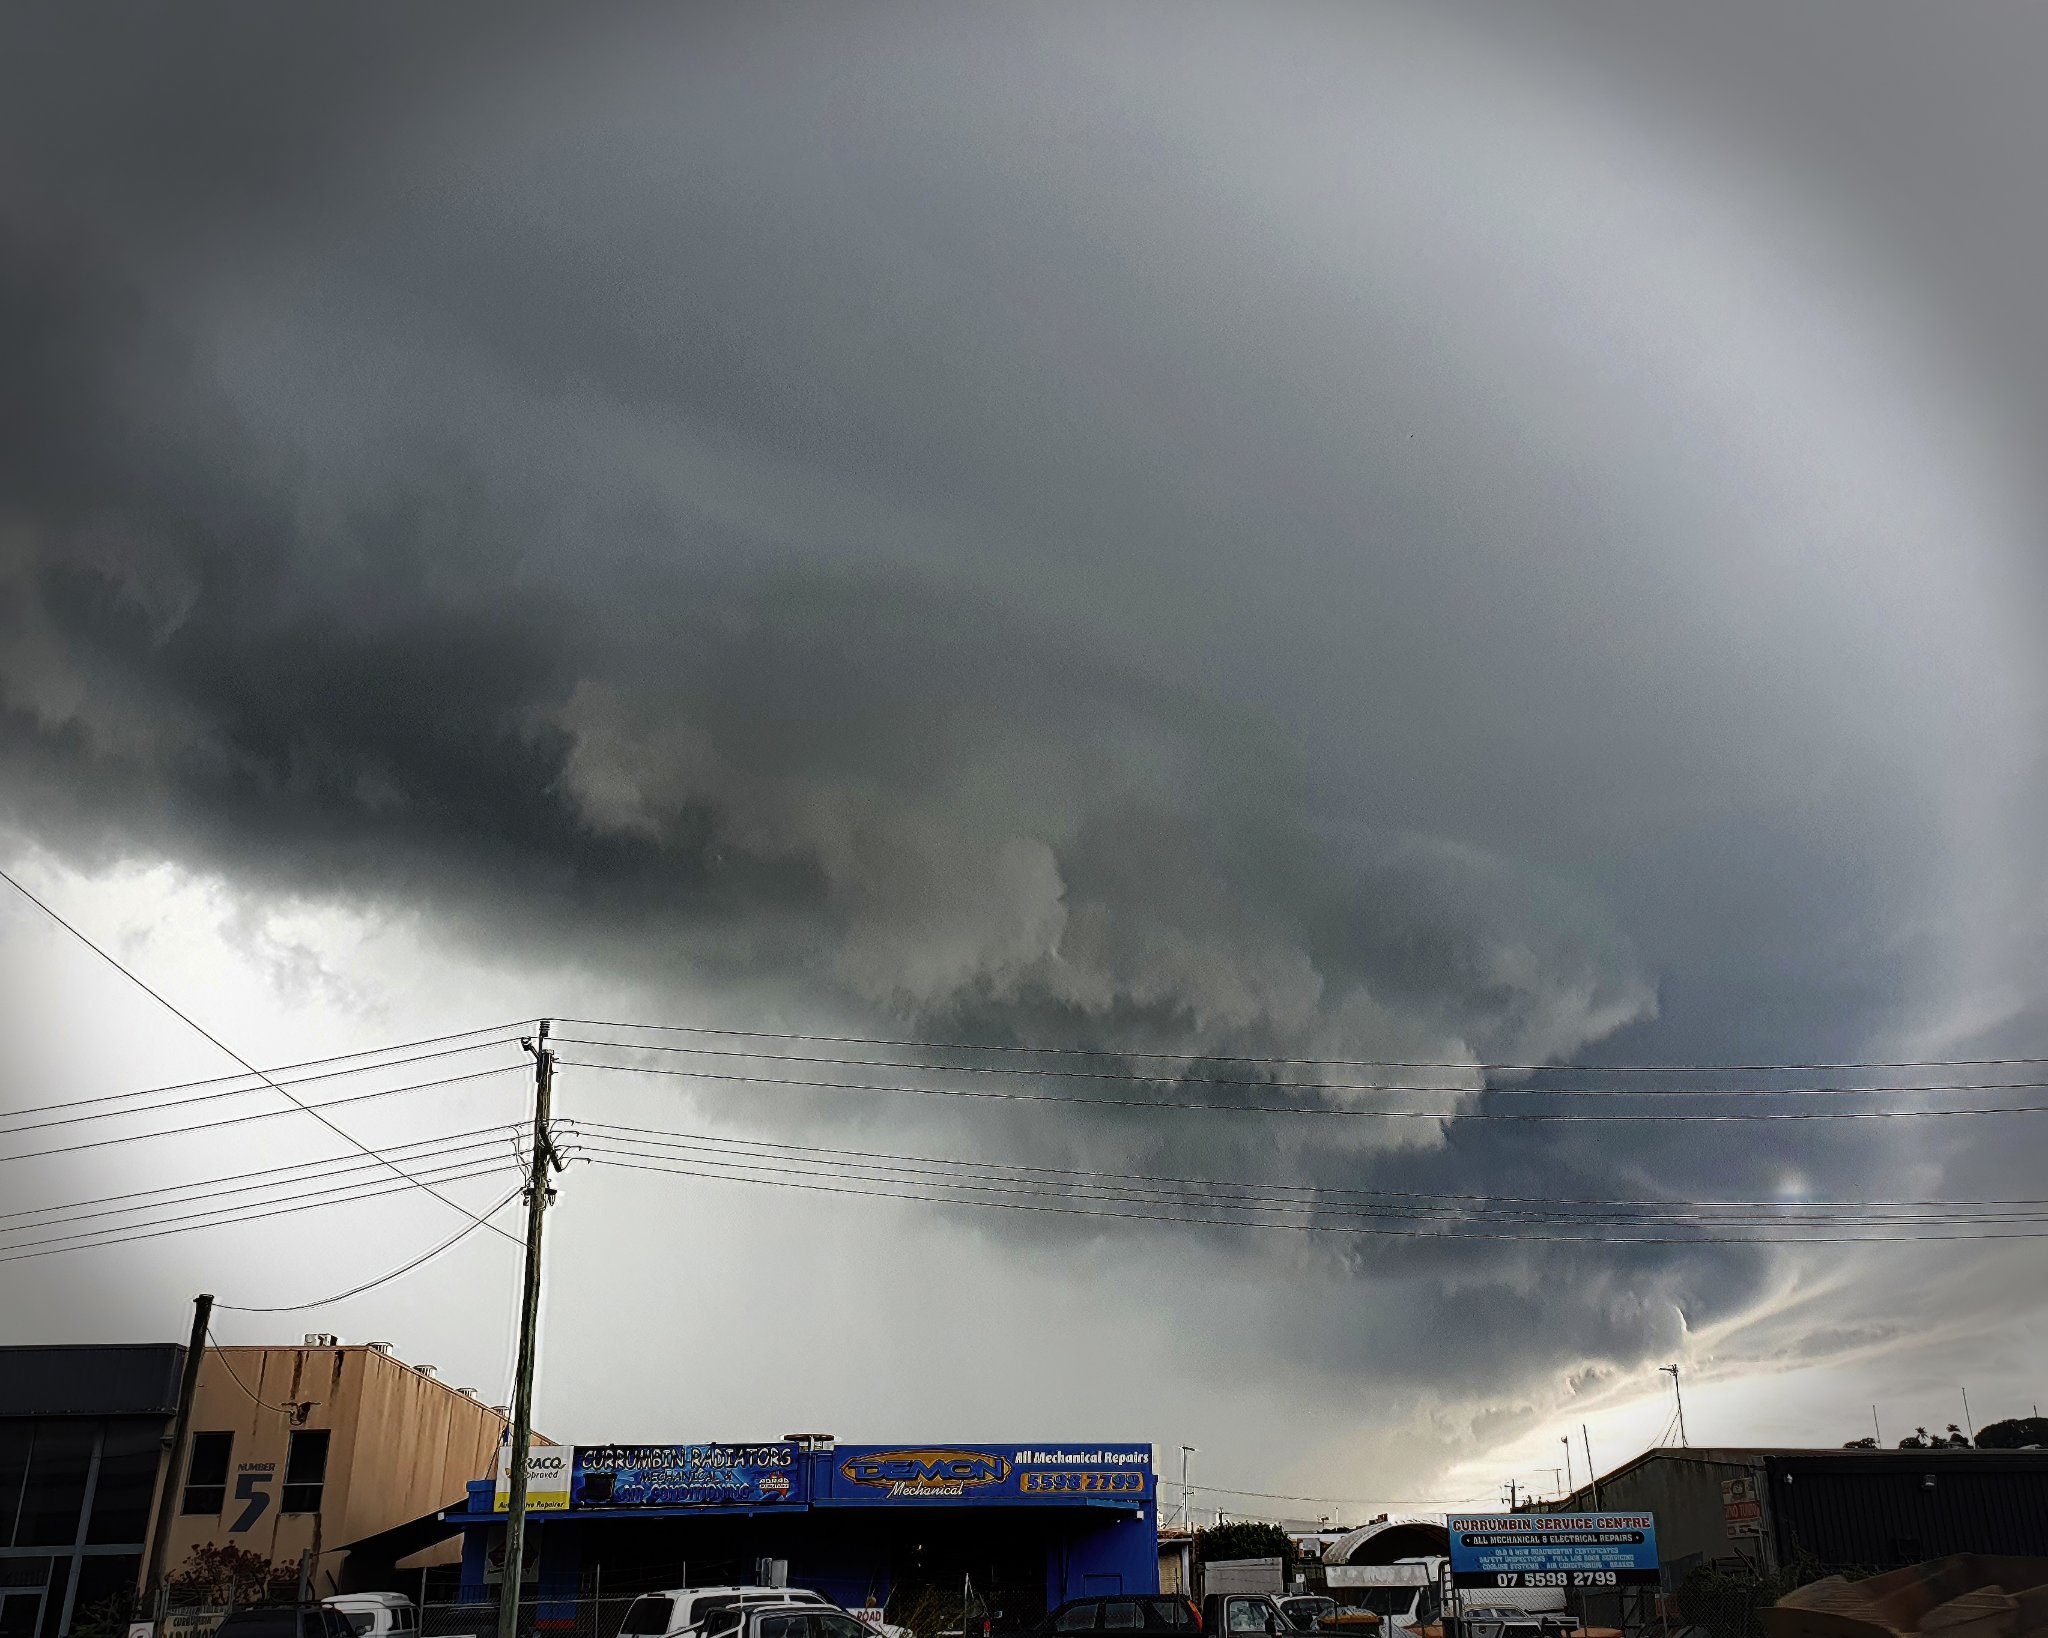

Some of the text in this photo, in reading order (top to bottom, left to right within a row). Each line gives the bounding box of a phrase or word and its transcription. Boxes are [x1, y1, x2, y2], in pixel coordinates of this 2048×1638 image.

[583, 1447, 792, 1469] CURRUMBIN RADIATORS
[1015, 1450, 1149, 1466] All Mechanical Repairs
[238, 1463, 276, 1472] NUMBER
[526, 1470, 559, 1480] pproved
[848, 1459, 1005, 1481] DEMON
[641, 1471, 717, 1482] MECHANICAL
[1027, 1473, 1140, 1490] 5598 2799
[650, 1483, 750, 1500] CONDITIONING
[886, 1480, 965, 1499] Mechanical
[228, 1474, 273, 1533] 5
[1453, 1516, 1651, 1532] CURRUMBIN SERVICE CENTRE
[1474, 1536, 1488, 1545] ALL
[1490, 1535, 1540, 1544] MECHANICAL
[1550, 1534, 1597, 1543] ELECTRICAL
[1600, 1534, 1633, 1542] REPAIRS
[1497, 1571, 1617, 1587] 07 5598 2799
